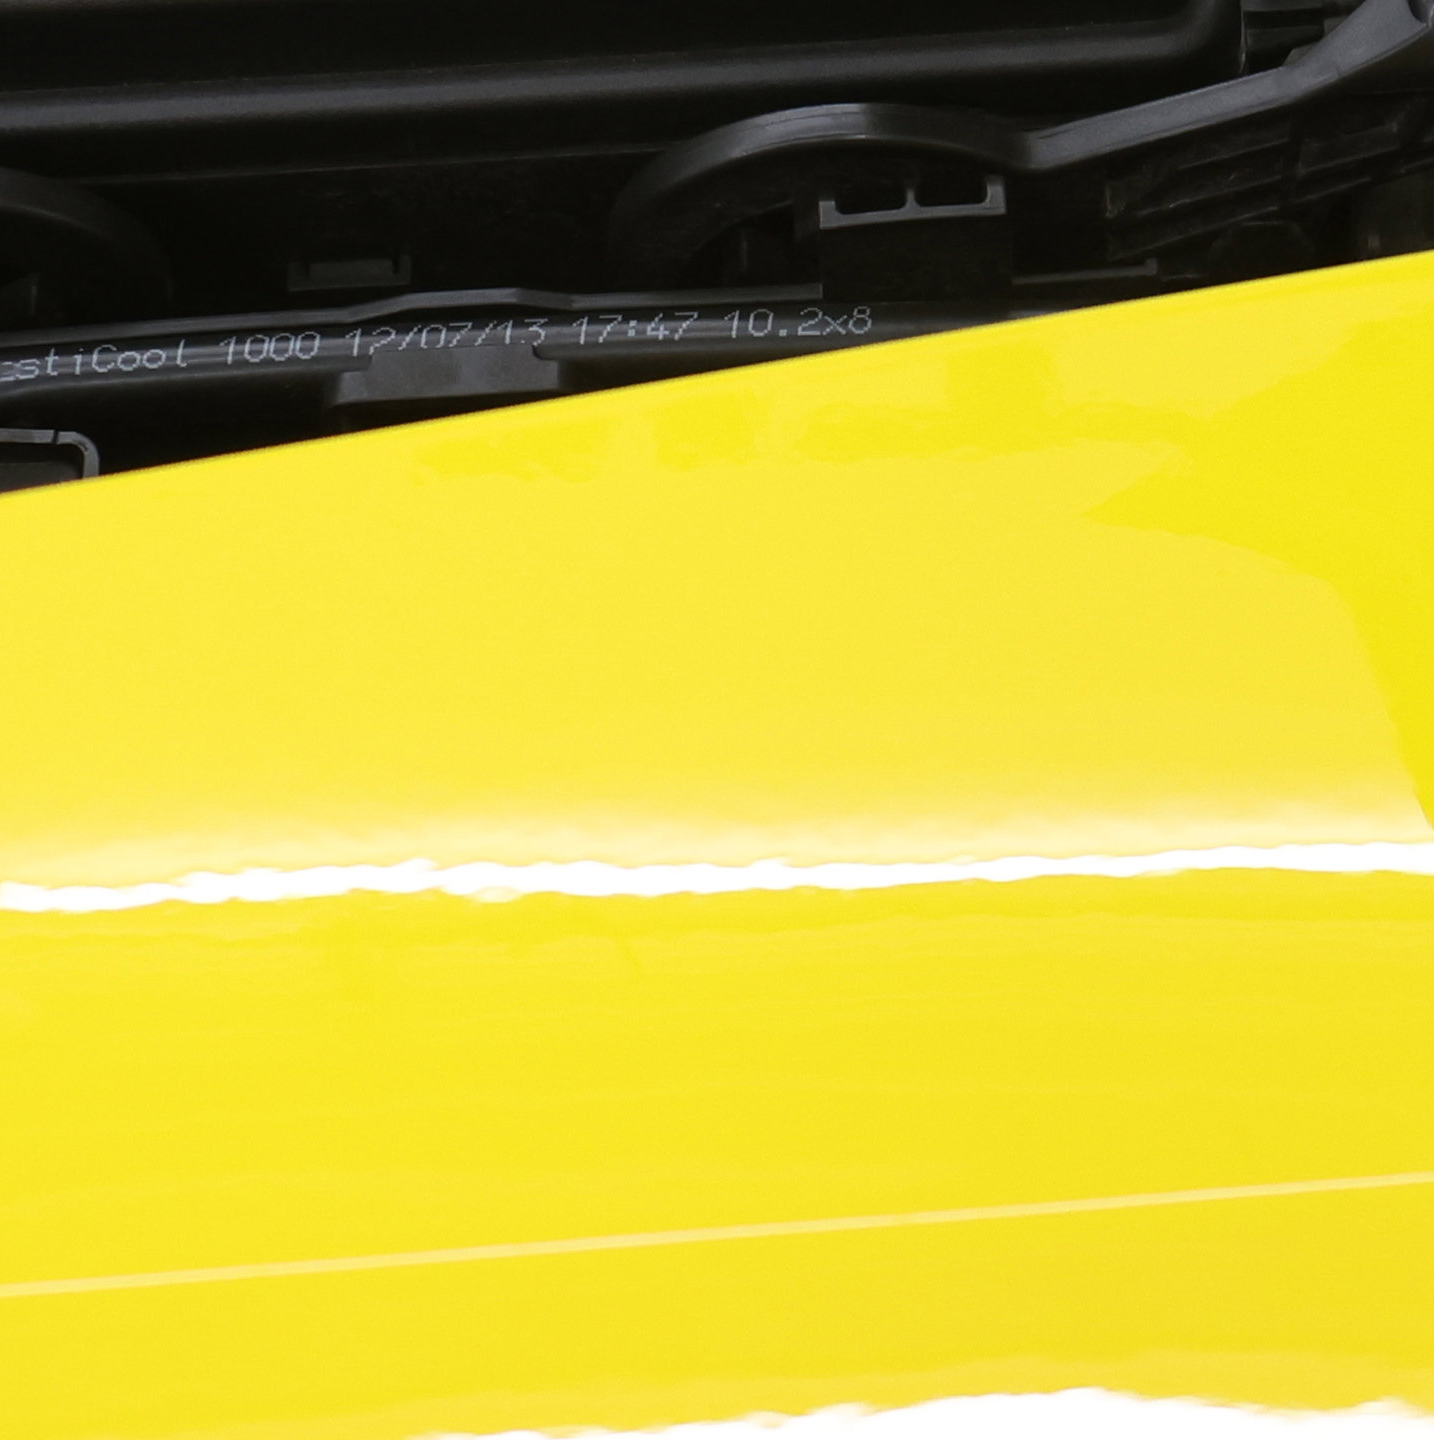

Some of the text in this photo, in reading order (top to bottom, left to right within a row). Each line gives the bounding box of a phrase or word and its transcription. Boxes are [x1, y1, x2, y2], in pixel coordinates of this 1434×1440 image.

[219, 331, 320, 366] 1000
[344, 317, 549, 358] 12/07/13
[572, 311, 700, 345] 17:47
[724, 305, 872, 339] 10.2x8
